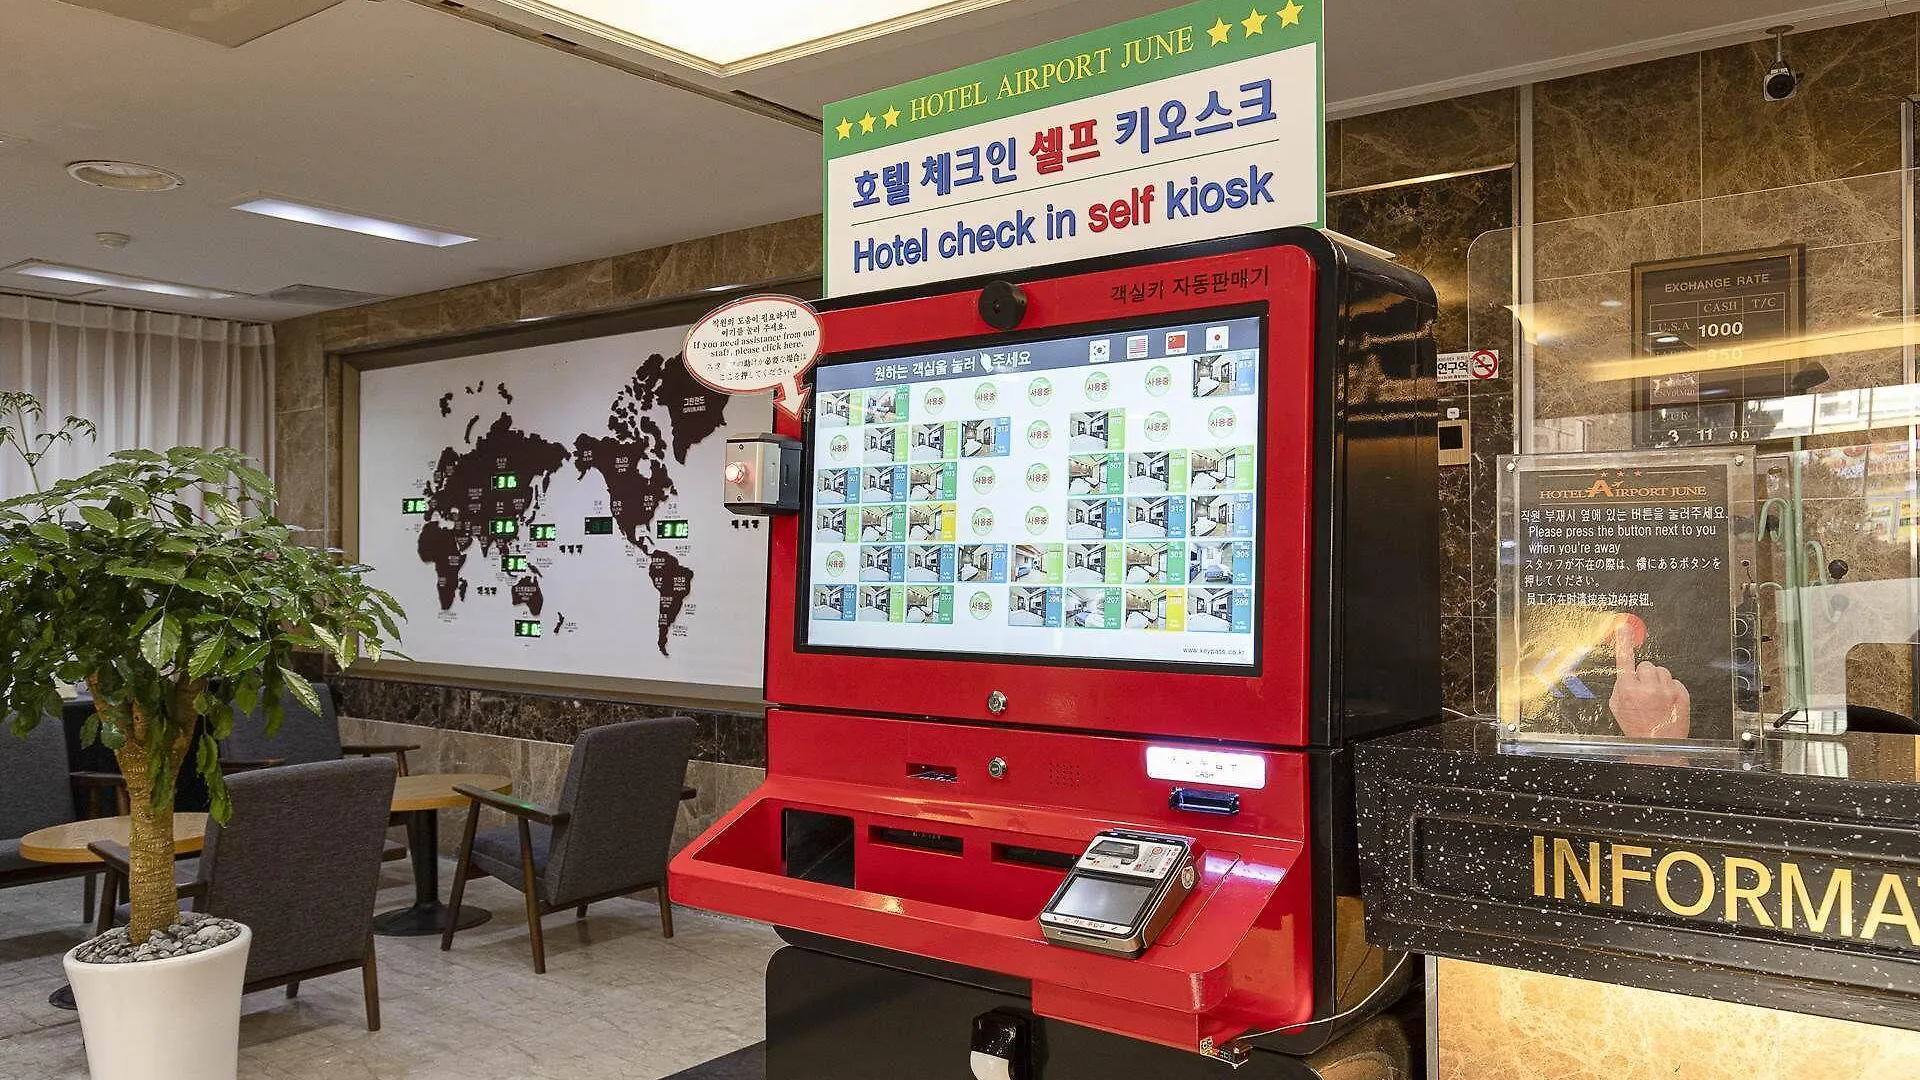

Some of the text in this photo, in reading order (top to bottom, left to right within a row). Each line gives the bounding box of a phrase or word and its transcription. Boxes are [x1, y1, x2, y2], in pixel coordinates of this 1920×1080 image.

[909, 26, 1195, 122] HOTEL AIRPORT JUNE
[851, 77, 1278, 209] 호텔 체크인 셀프 키오스크
[853, 164, 1275, 274] Hotel check in self kiosk
[1172, 265, 1269, 296] 자동판매기
[1665, 273, 1769, 293] EXCHANGE RATE
[1704, 297, 1776, 313] CASH T/C
[693, 329, 817, 349] If you need assistance from our
[1699, 321, 1743, 337] 1000
[735, 345, 760, 357] please
[762, 342, 781, 352] click
[783, 340, 804, 350] here.
[874, 350, 1031, 382] 원하는 객실을 눌러 주세요
[1540, 479, 1707, 499] HOTEL AIRPORT JUNE
[1521, 506, 1728, 523] 직원 부재시 옆에 있는 버튼을 눌러주세요.
[1529, 524, 1716, 539] Please press the button next to you
[1529, 542, 1621, 555] when you're away
[1524, 574, 1600, 588] 押してください。
[1533, 835, 1920, 947] INFORMA
